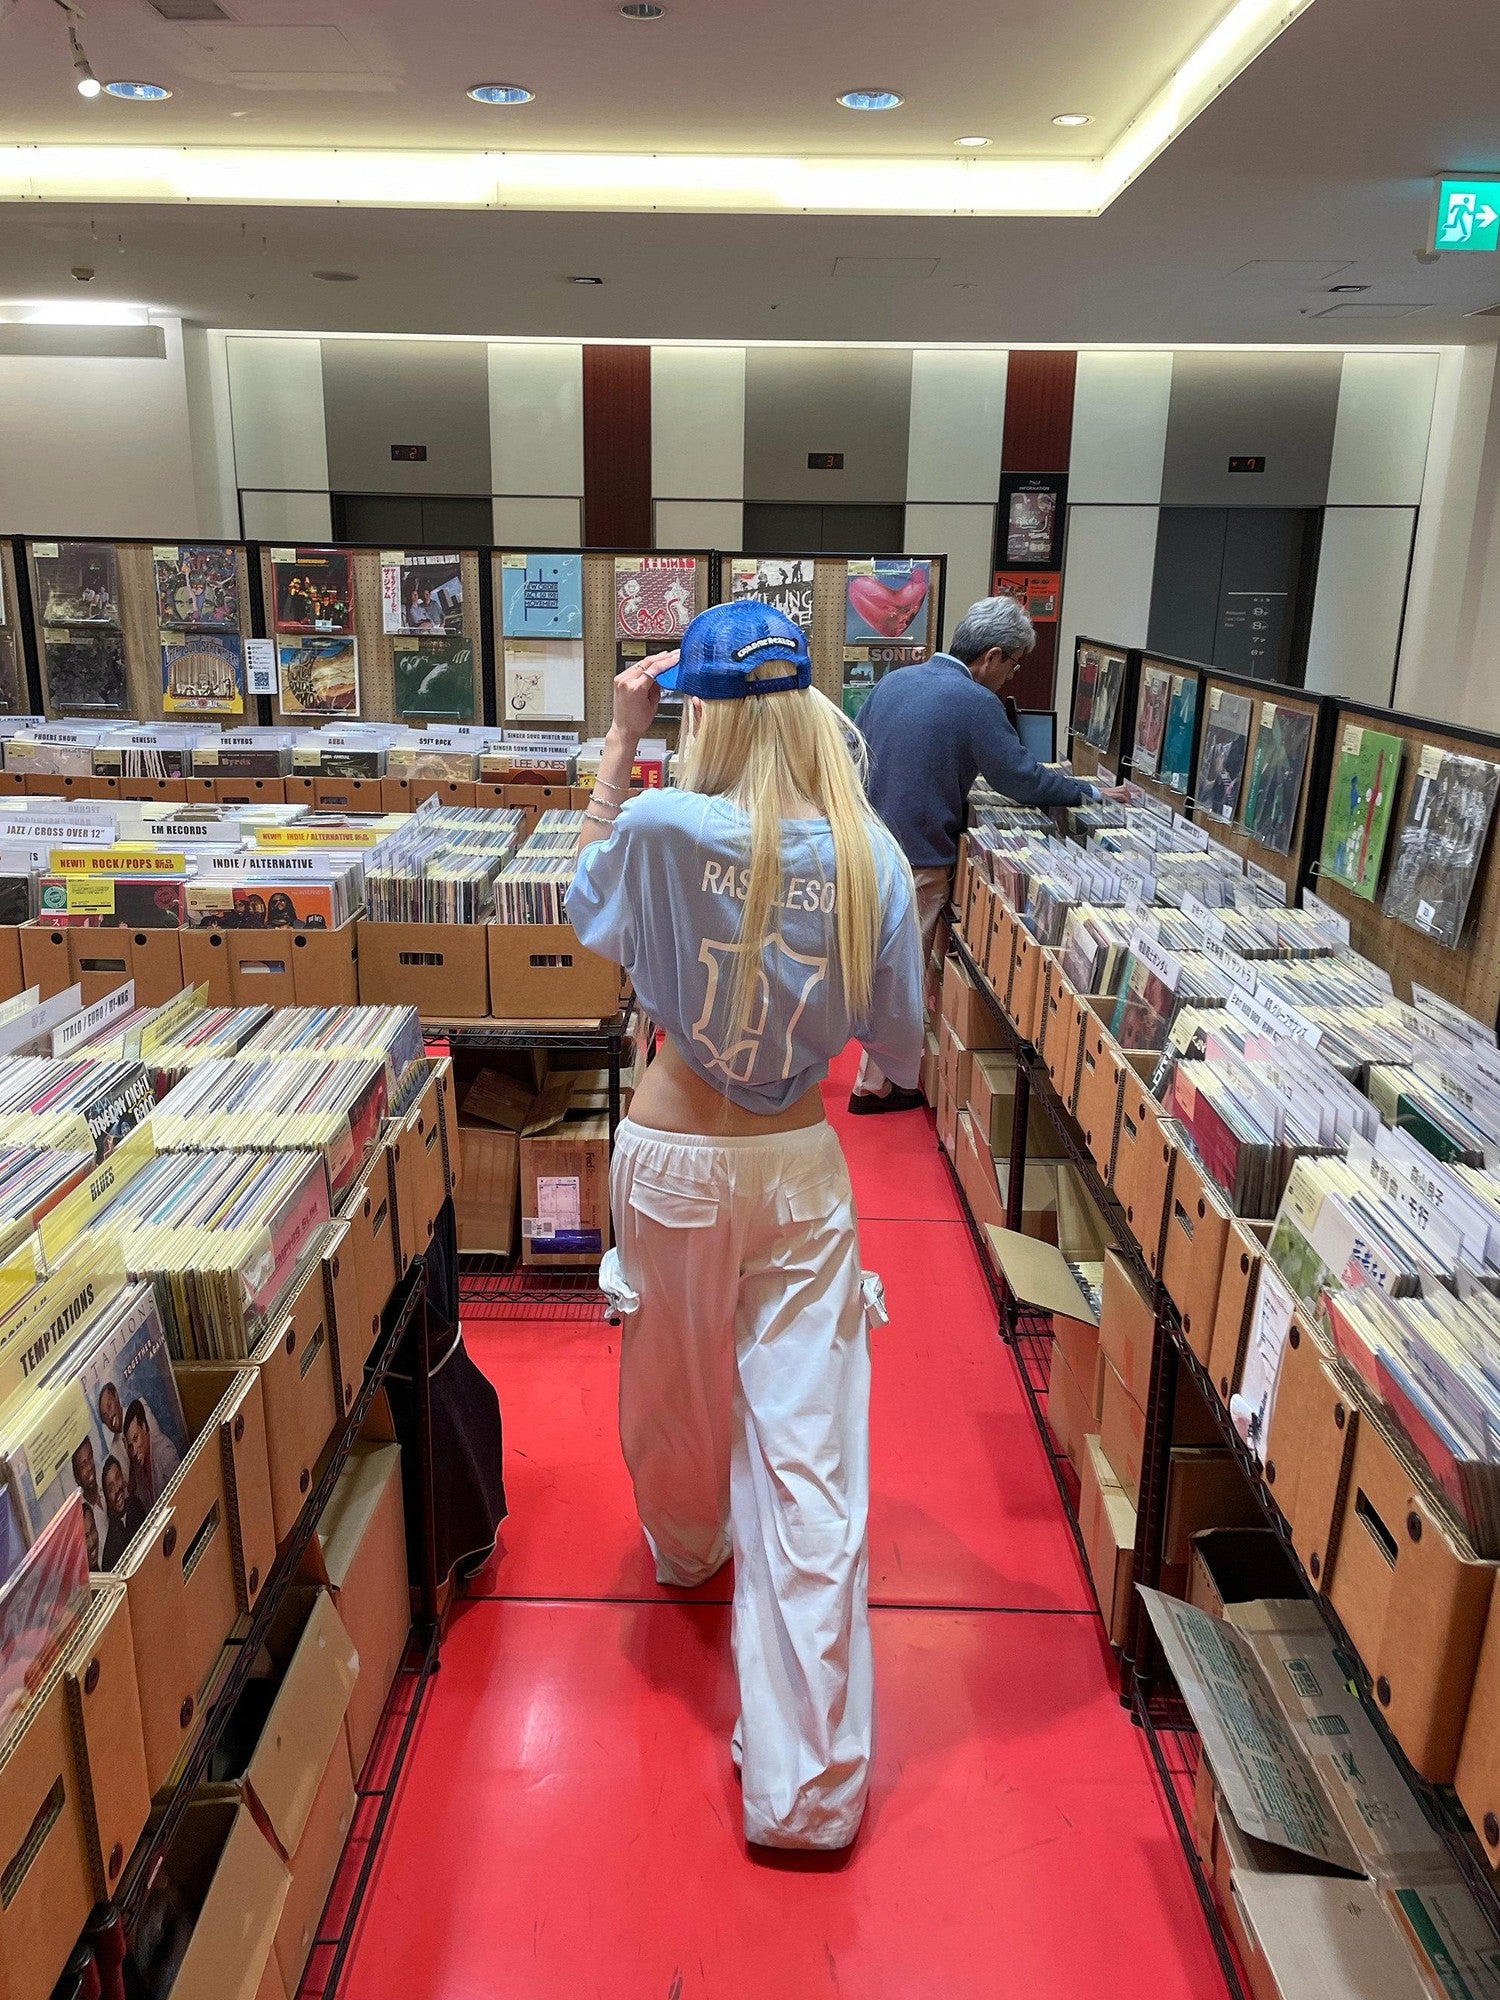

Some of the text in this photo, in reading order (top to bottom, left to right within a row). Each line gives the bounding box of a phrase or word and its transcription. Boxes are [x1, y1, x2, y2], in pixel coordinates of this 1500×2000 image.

[514, 760, 532, 768] LEE
[534, 760, 566, 770] JONES
[6, 826, 26, 835] JAZZ
[34, 826, 64, 837] CROSS
[66, 828, 88, 838] OVER
[152, 825, 208, 836] EM RECORDS
[286, 833, 304, 841] INDIE
[310, 834, 354, 842] ALTERNATIVE
[60, 858, 86, 868] NEW!!
[212, 858, 240, 868] INDIE
[250, 858, 314, 869] ALTERNATIVE
[62, 1020, 82, 1043] ITALO
[88, 1007, 104, 1026] EURO
[90, 1166, 115, 1202] BLUES
[20, 1283, 94, 1378] TEMPTATIONS
[80, 1294, 155, 1393] PTATIONS
[122, 1340, 152, 1378] TOGETHER
